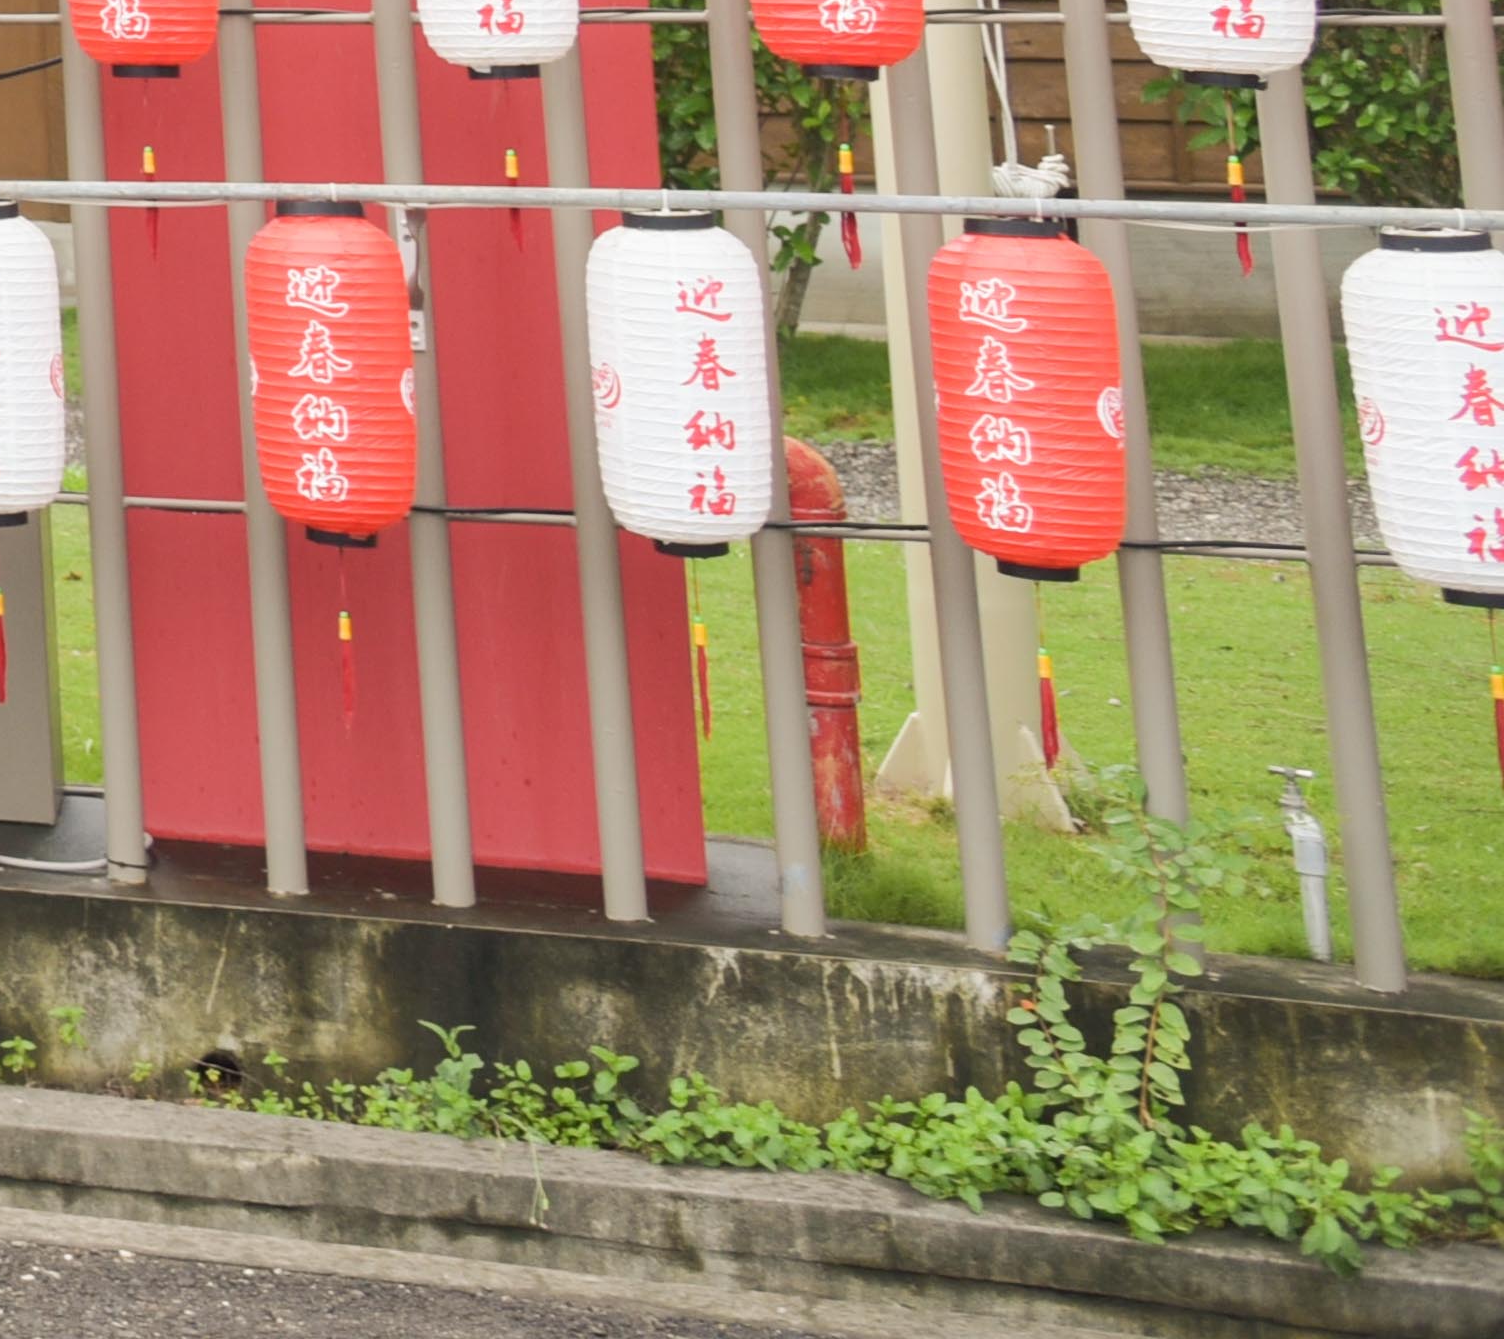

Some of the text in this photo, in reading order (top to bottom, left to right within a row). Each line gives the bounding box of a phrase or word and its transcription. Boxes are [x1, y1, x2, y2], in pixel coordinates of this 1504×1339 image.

[286, 264, 353, 503] 迎春納福
[675, 279, 738, 517] 迎春納福
[959, 276, 1035, 534] 迎春納福
